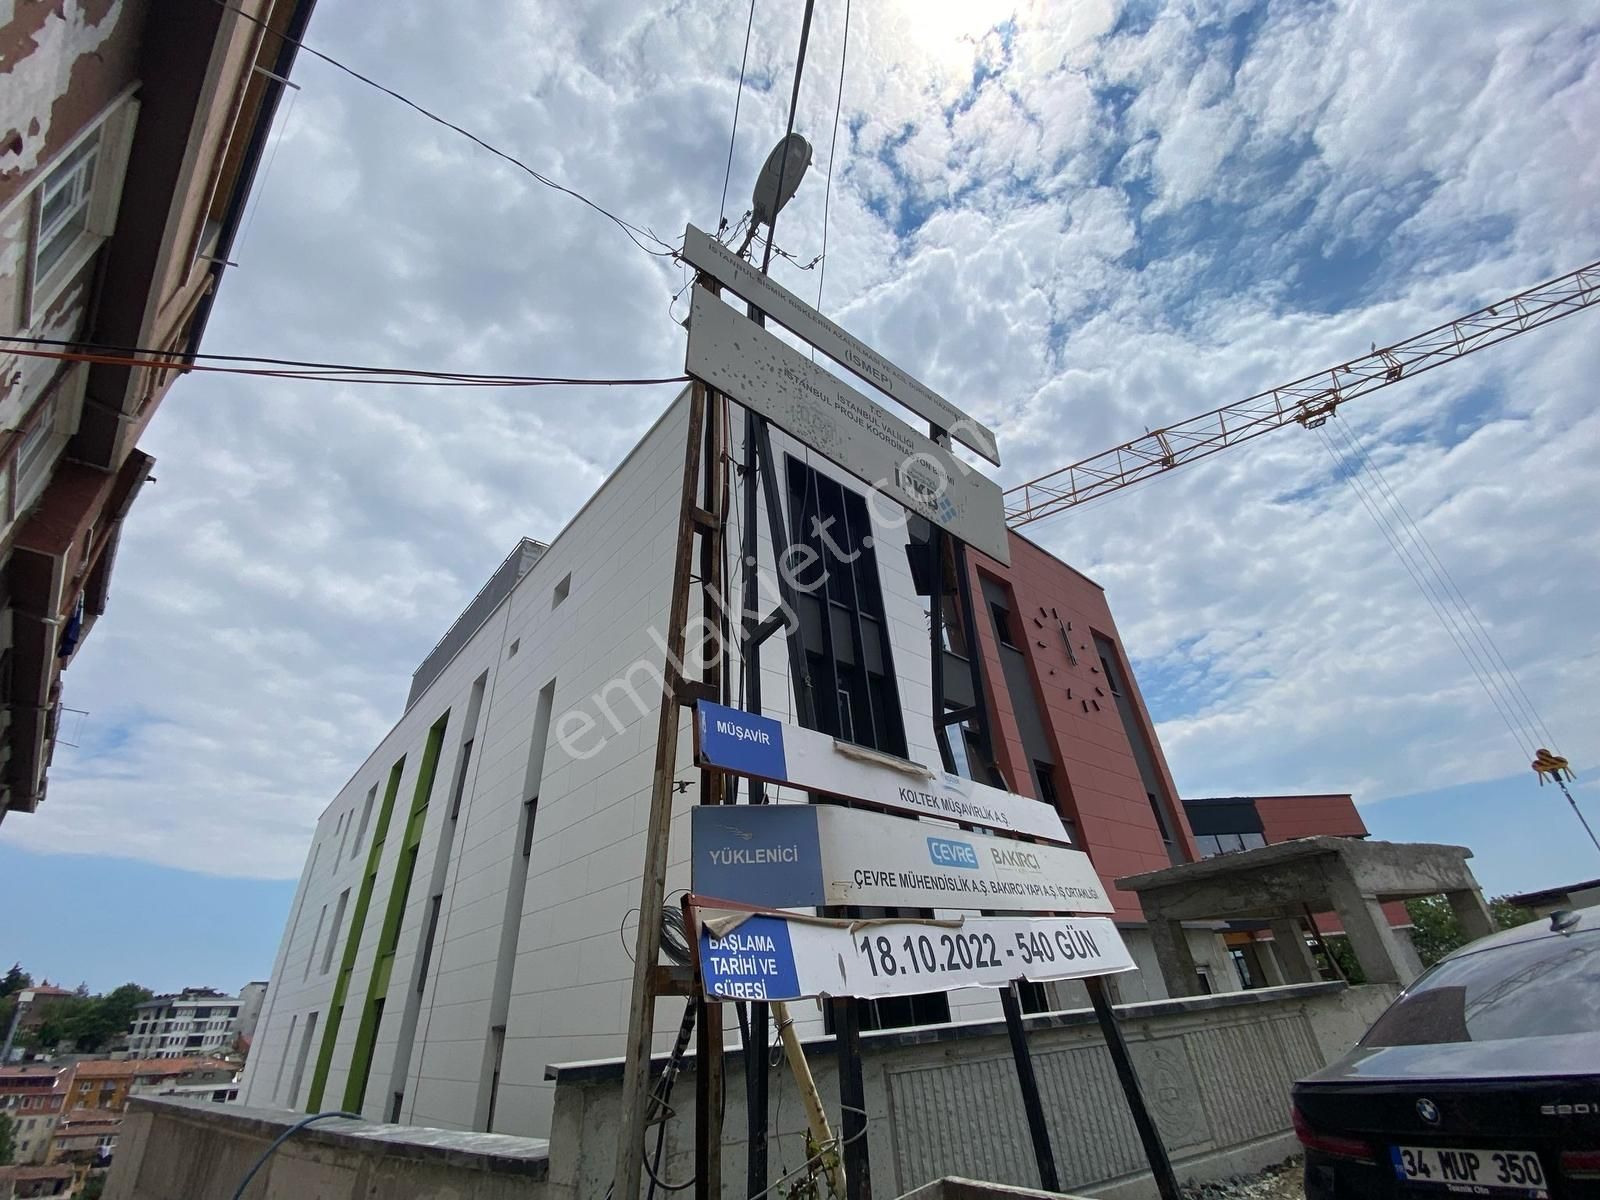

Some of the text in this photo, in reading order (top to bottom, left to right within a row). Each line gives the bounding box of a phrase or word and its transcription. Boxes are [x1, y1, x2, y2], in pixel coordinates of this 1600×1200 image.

[784, 367, 833, 407] İSTANBUL
[834, 402, 865, 428] PROJE
[837, 392, 880, 428] İSTANBUL
[716, 720, 770, 745] MÜŞAVİR
[898, 787, 940, 810] KOLTEK
[940, 797, 996, 822] MÜŞAVİRLİK
[709, 845, 798, 865] YÜKLENİCİ
[932, 842, 976, 864] ÇEVRE
[990, 847, 1041, 870] BAKIRCI
[854, 869, 897, 890] ÇEVRE
[898, 871, 972, 893] MÜHENDİSLİK
[991, 881, 1025, 896] BAKIRCI
[1024, 882, 1042, 897] YAPI
[709, 934, 776, 955] BAŞLAMA
[860, 933, 1003, 977] 18.10.2022
[1015, 931, 1055, 965] 540
[1055, 924, 1102, 961] GÜN
[710, 954, 778, 975] TARİHİ VE
[1402, 1150, 1431, 1178] 34
[1437, 1151, 1480, 1182] MUP
[1492, 1152, 1543, 1186] 350
